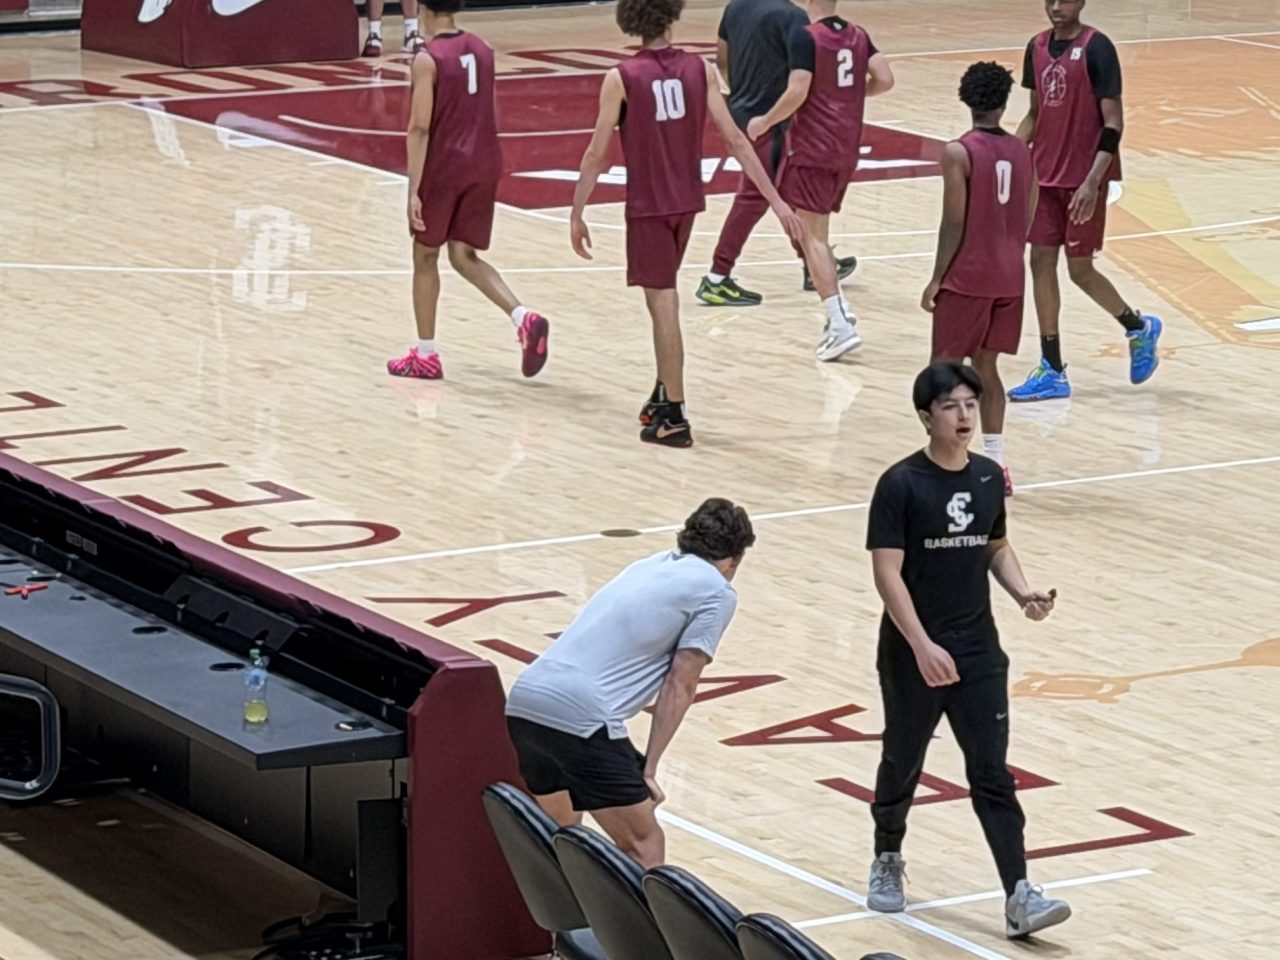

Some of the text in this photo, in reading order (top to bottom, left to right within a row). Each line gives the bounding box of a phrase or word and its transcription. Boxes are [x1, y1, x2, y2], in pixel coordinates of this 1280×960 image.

[837, 48, 854, 88] 2
[651, 78, 686, 121] 10
[995, 159, 1012, 205] 0
